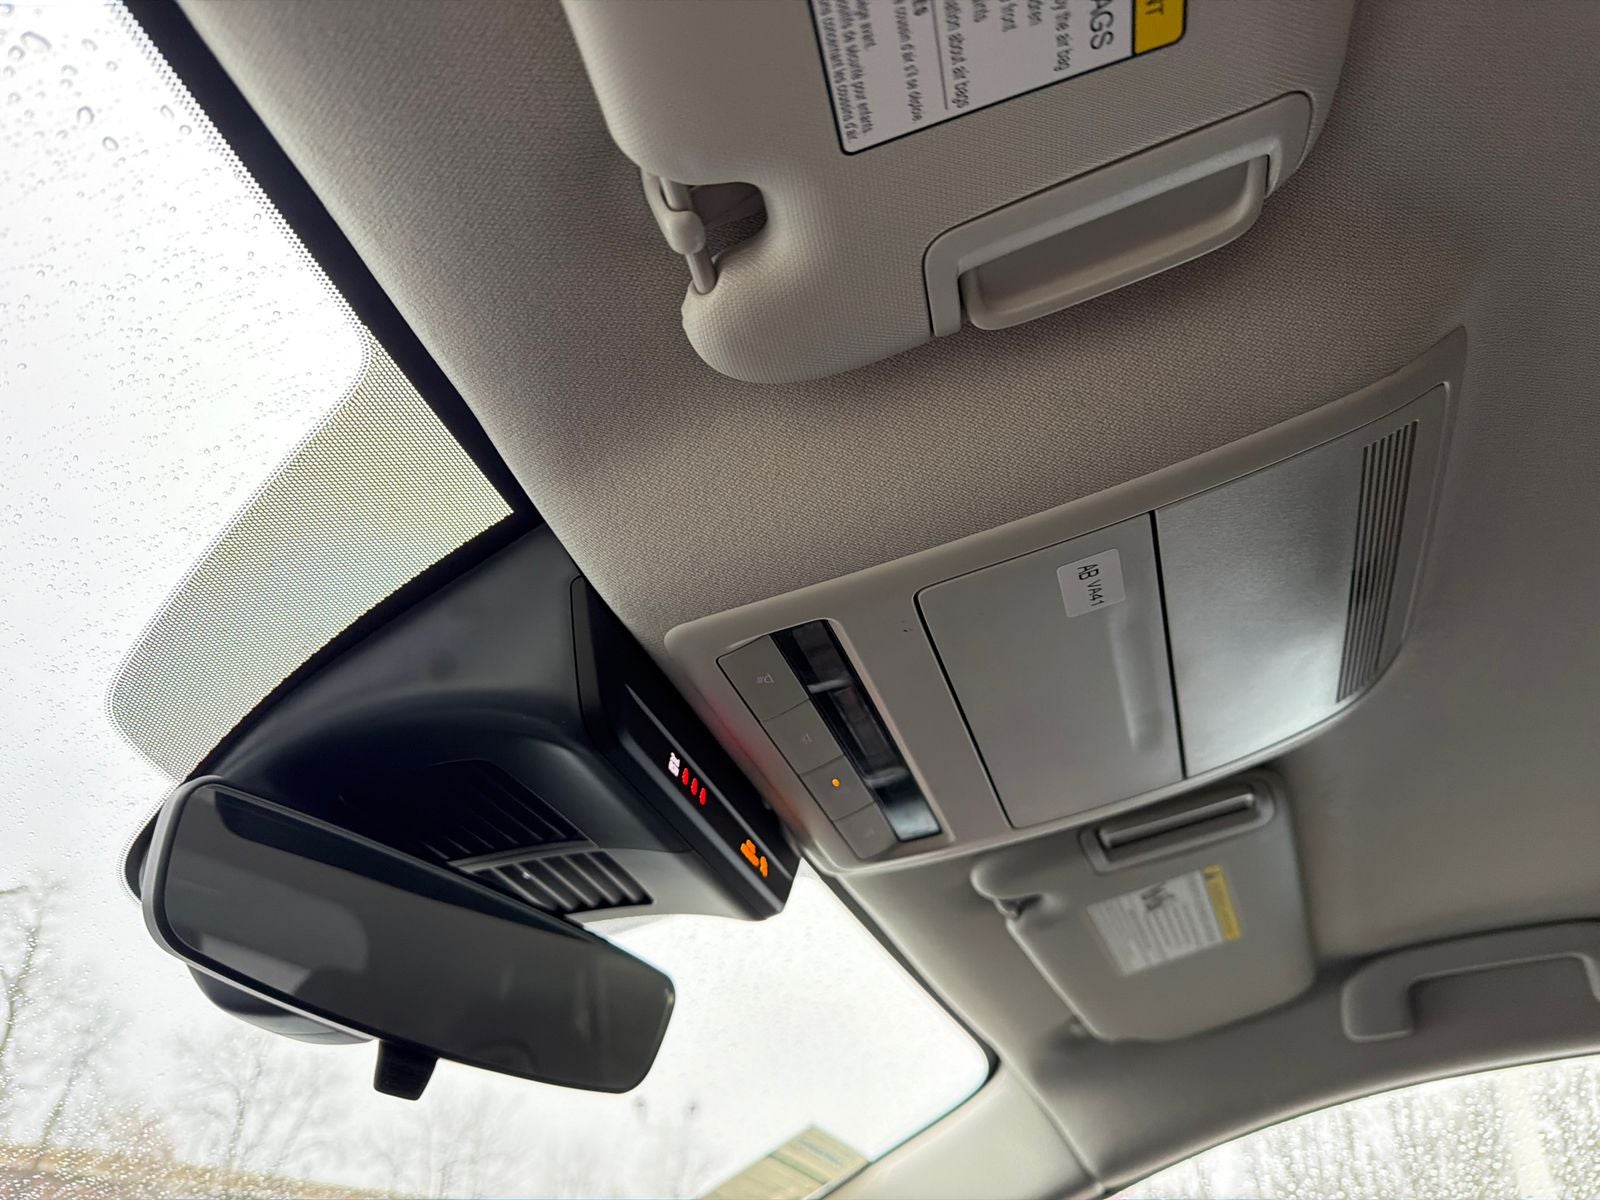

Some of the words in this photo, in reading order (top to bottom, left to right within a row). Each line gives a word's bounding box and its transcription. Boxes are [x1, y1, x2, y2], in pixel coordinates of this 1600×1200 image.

[949, 33, 968, 65] about
[1053, 48, 1075, 72] bag
[952, 81, 971, 109] bags
[1077, 564, 1100, 580] AB
[1087, 579, 1104, 607] VA41
